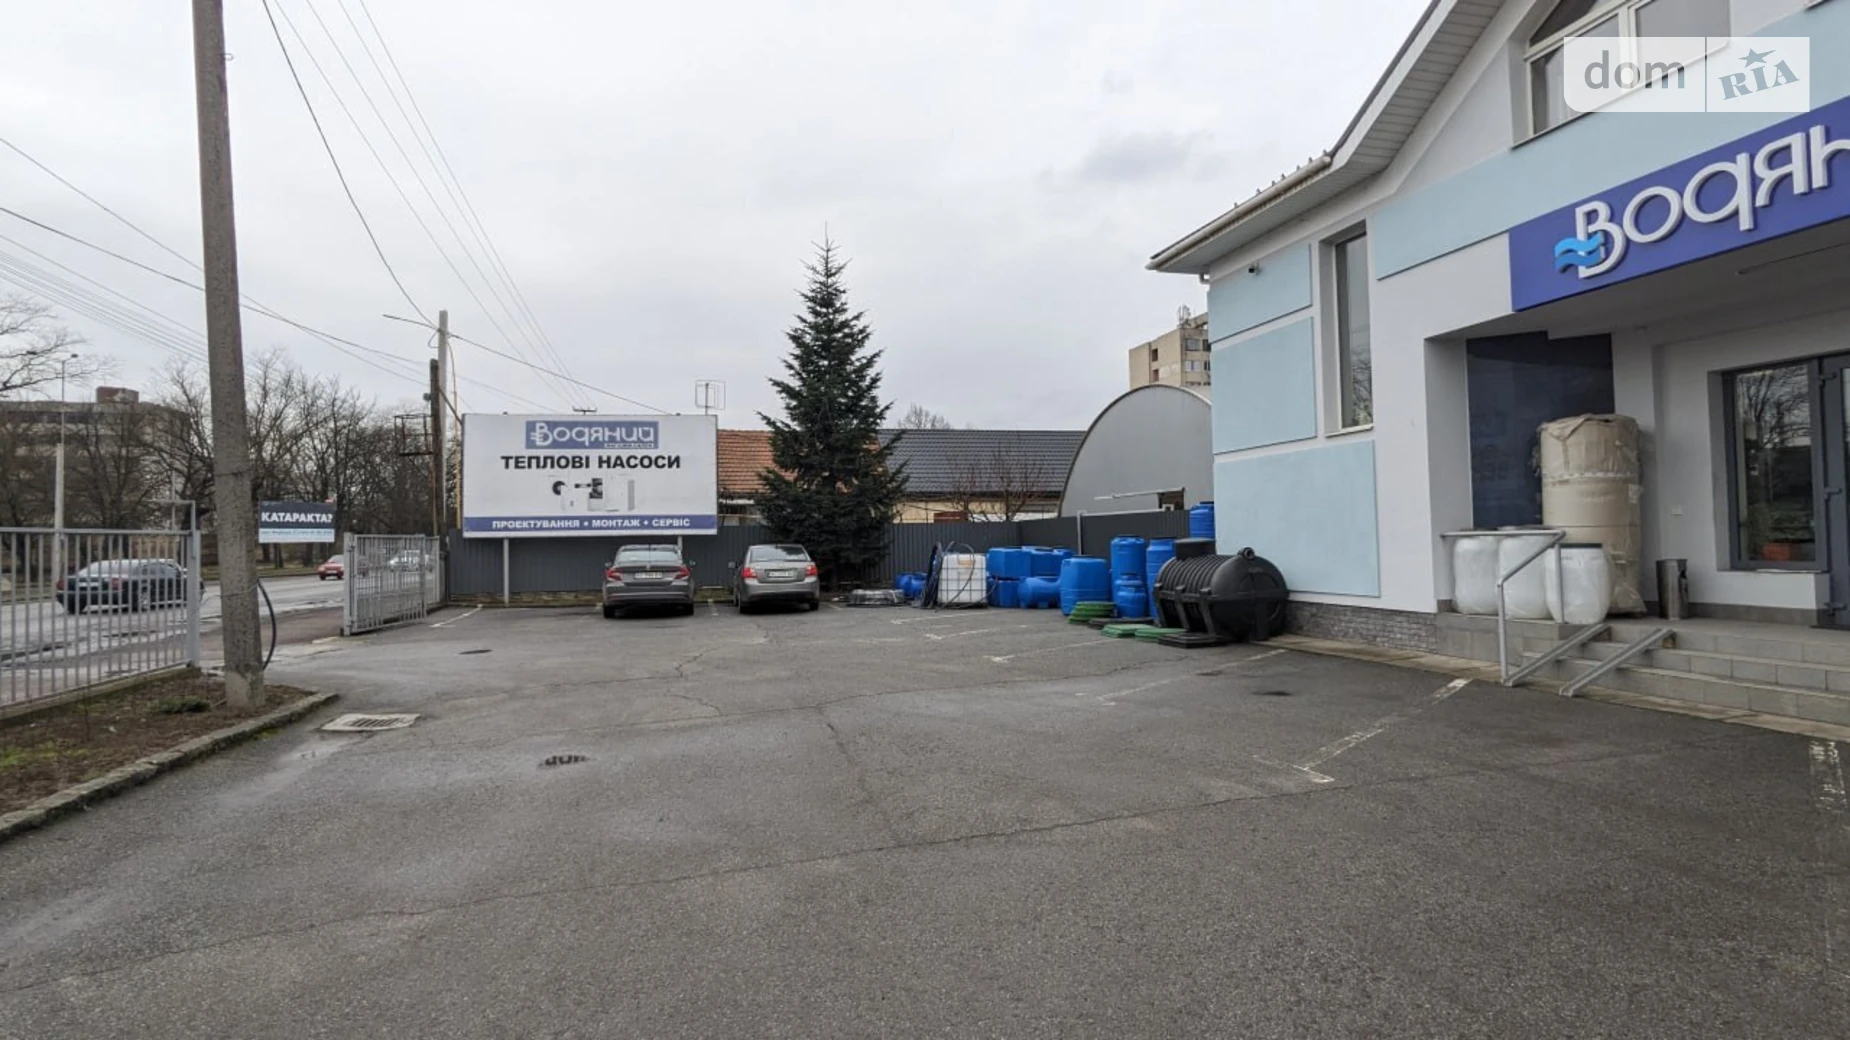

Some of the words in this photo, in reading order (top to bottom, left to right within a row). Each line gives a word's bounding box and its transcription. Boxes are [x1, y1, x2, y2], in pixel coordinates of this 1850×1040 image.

[501, 455, 590, 469] ТЕПЛОВІ
[598, 455, 681, 469] НАСОСИ
[261, 511, 333, 523] КАТАРАКТА?
[492, 519, 580, 529] ПРОЕКТУВАННЯ
[592, 518, 641, 528] МОНТАЖ
[651, 518, 691, 527] СЕРВІС
